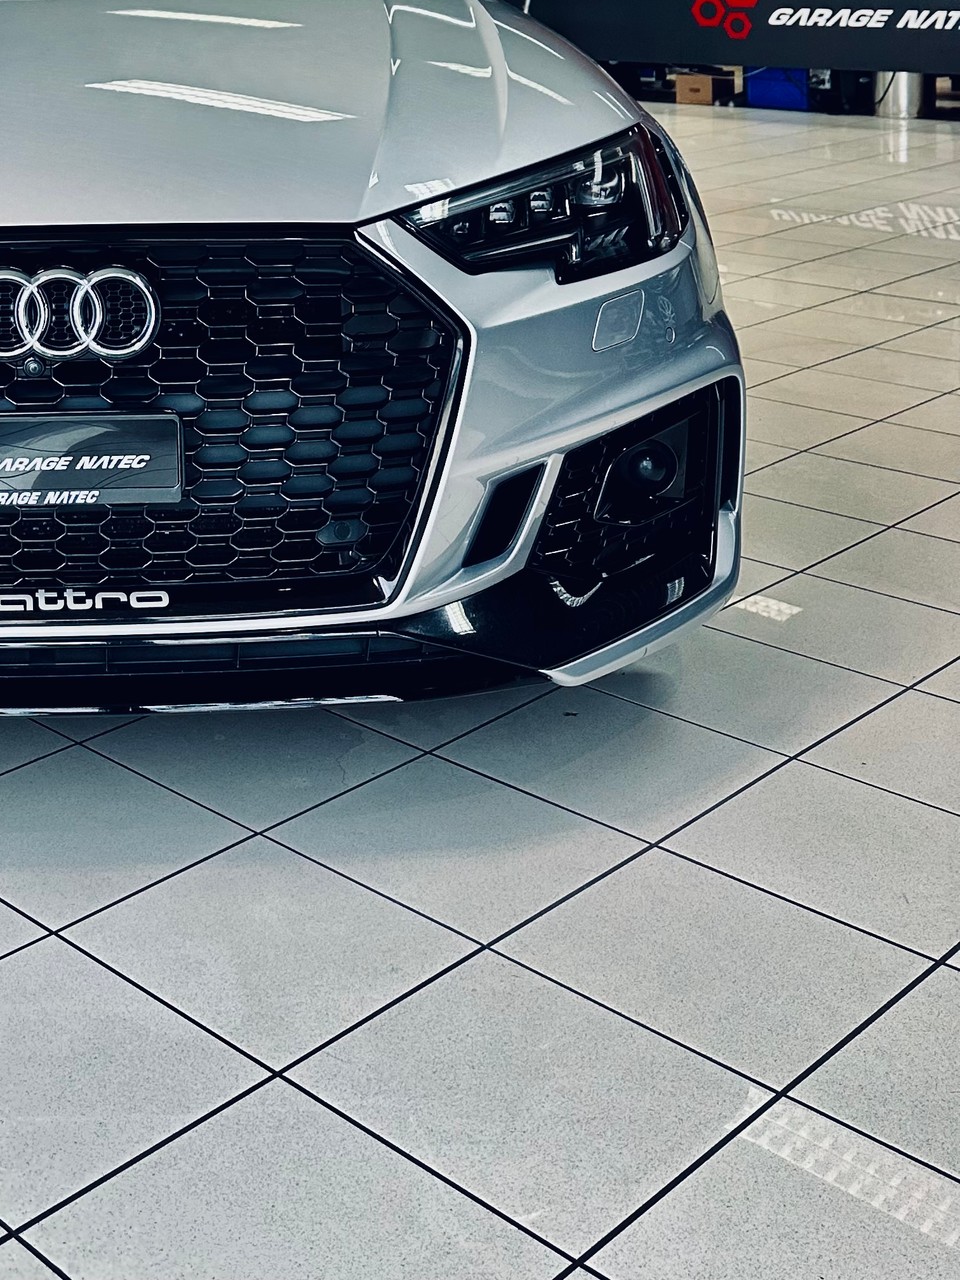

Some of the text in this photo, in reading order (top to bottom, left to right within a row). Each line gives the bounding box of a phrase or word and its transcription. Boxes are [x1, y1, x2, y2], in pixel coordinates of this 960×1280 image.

[768, 7, 960, 30] GARAGE NAT
[75, 454, 151, 470] NATEC
[43, 490, 100, 504] NATEC
